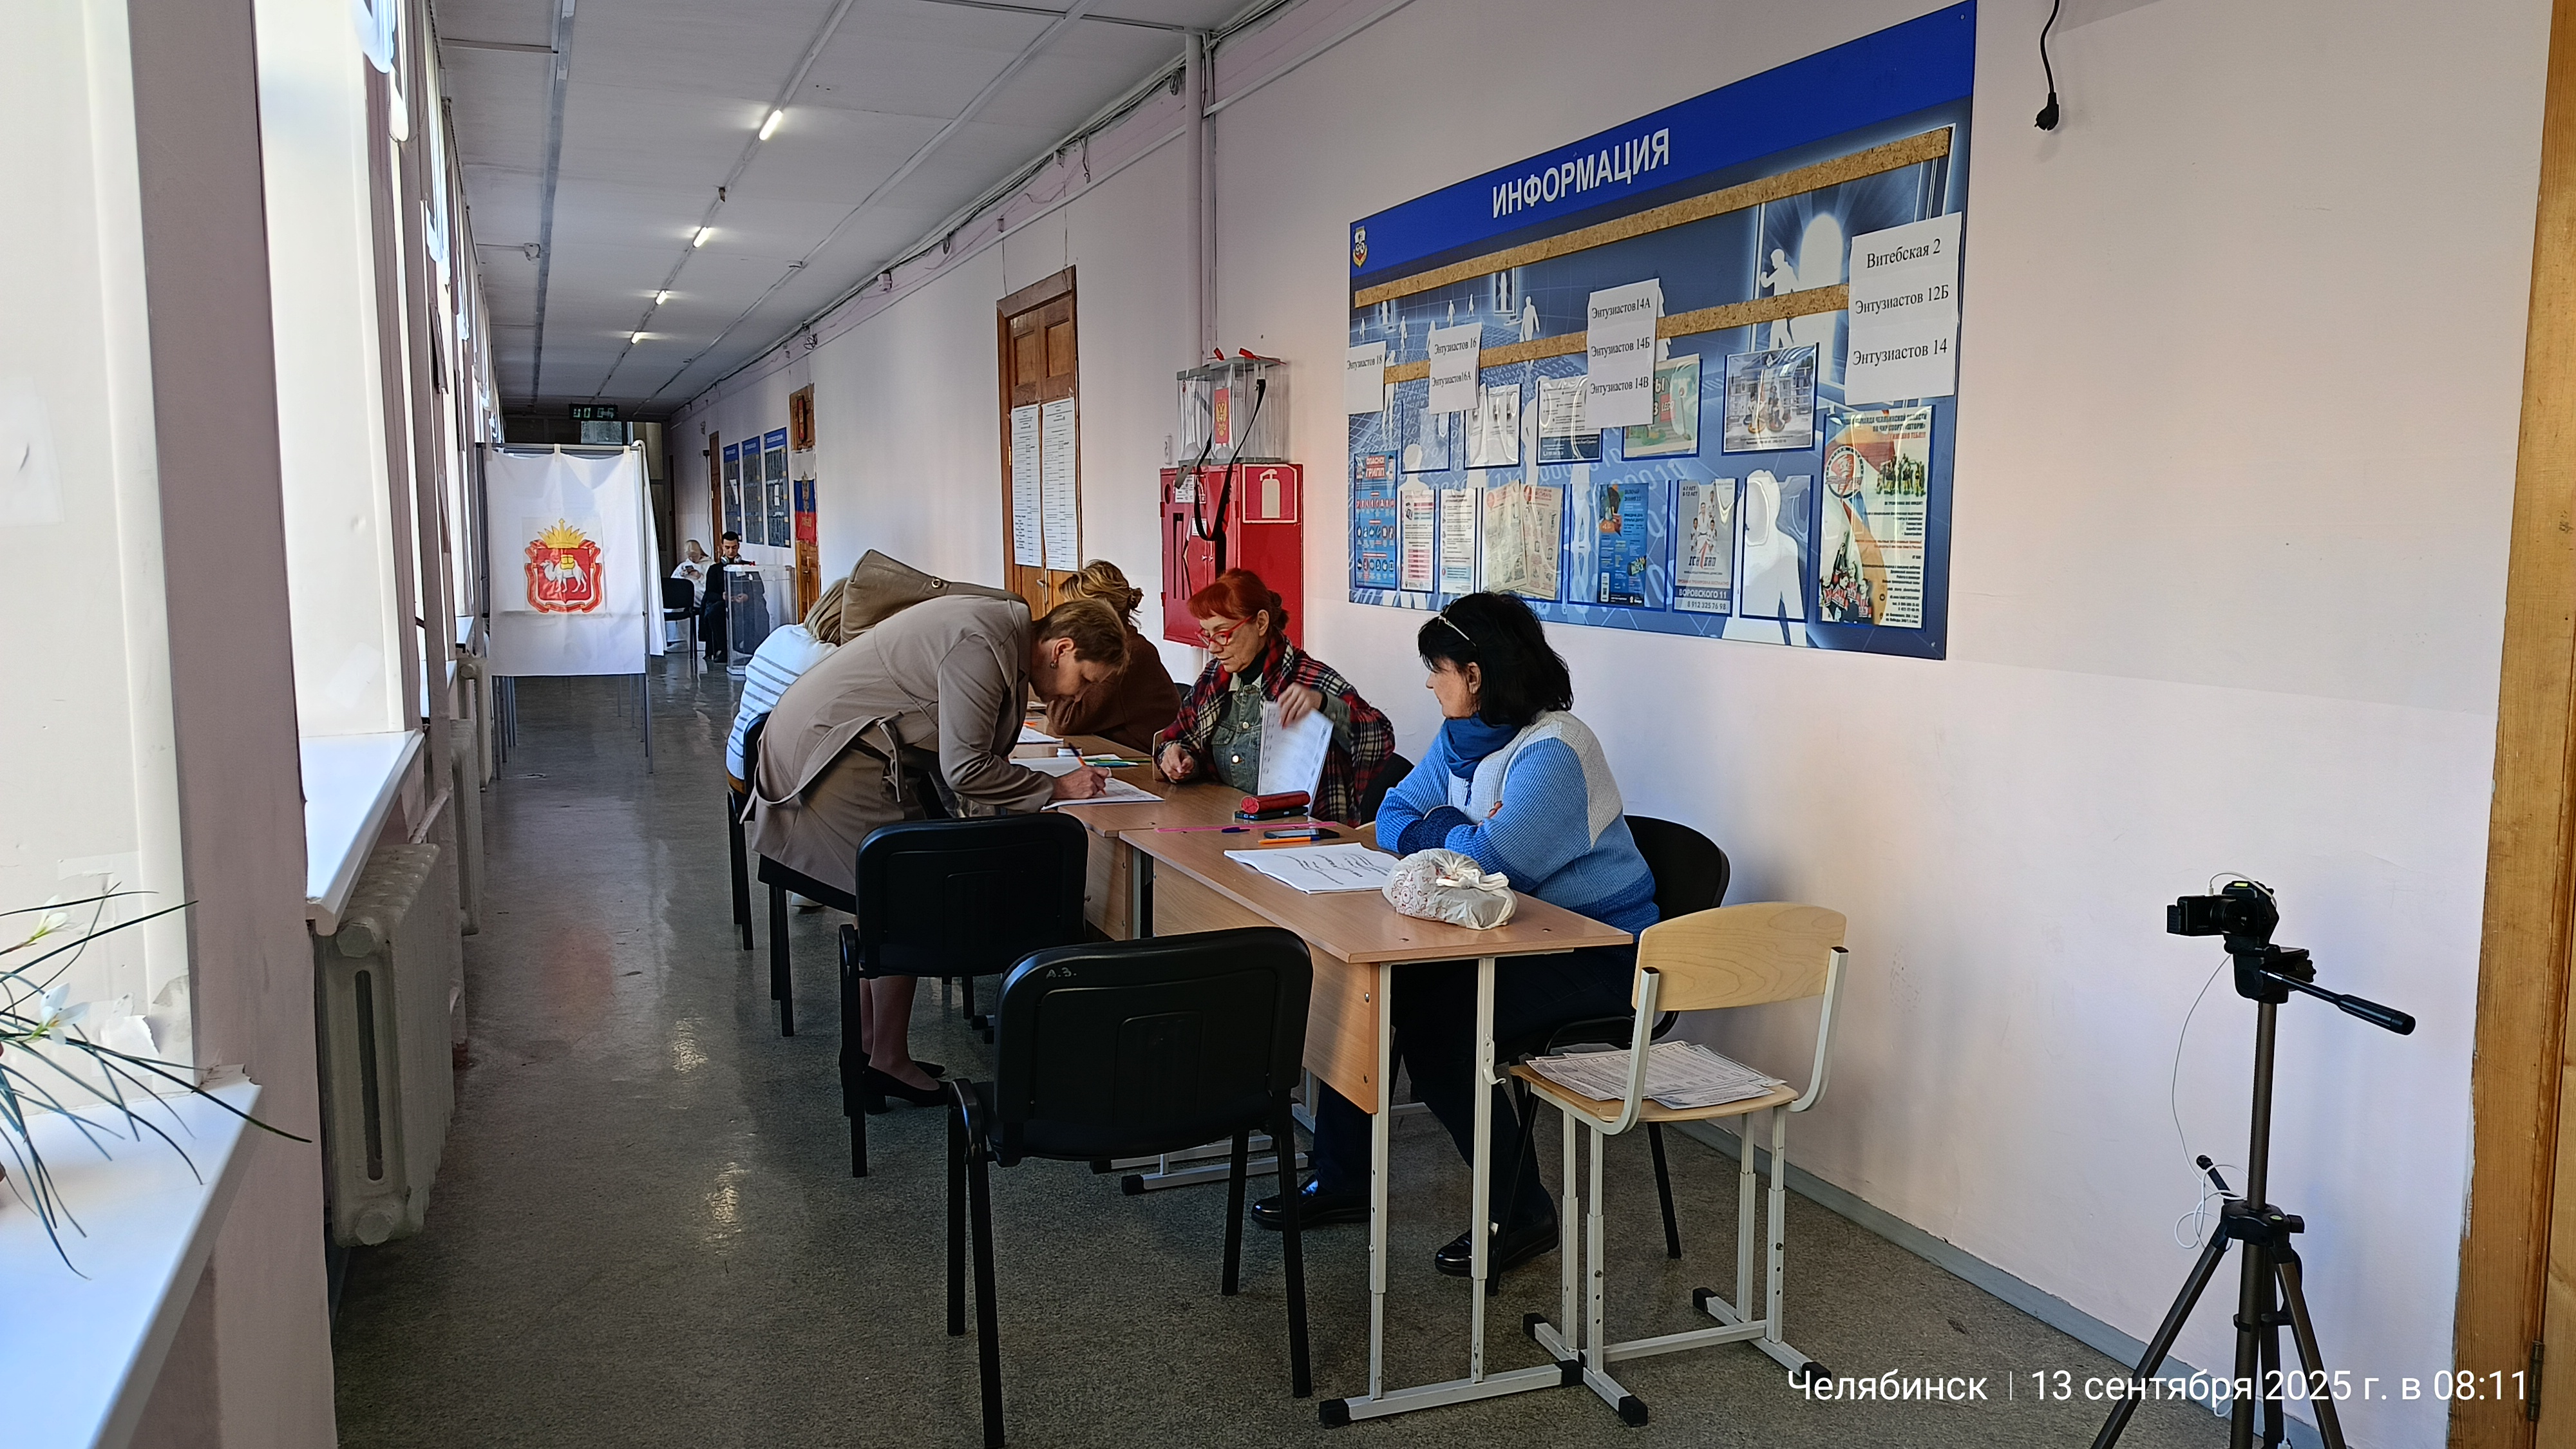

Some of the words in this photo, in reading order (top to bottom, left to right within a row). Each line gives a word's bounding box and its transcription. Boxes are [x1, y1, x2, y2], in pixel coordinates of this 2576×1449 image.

[1493, 128, 1669, 219] ИНФОРМАЦИЯ
[1866, 244, 1929, 269] Витебская
[1933, 238, 1941, 254] 2
[1591, 298, 1651, 319] Энтузиастов14А
[1855, 293, 1923, 314] Энтузиастов
[1927, 285, 1949, 301] 12Б
[1434, 342, 1468, 356] Энтузиастов
[1470, 337, 1477, 348] 16
[1591, 341, 1634, 358] Энтузиастов
[1636, 337, 1650, 350] 14Б
[1852, 345, 1928, 366] Энтузиастов
[1933, 338, 1947, 355] 14
[1347, 358, 1375, 370] Энтузиастов
[1376, 355, 1383, 365] 18
[1432, 371, 1472, 388] Энтузиастов16А
[1590, 381, 1633, 396] Энтузиастов
[1635, 376, 1649, 389] 14В
[1661, 400, 1674, 412] LEGO
[1365, 468, 1385, 477] ГРИПП
[1679, 588, 1718, 599] ВОРОВСКОГО
[1719, 591, 1727, 599] 11
